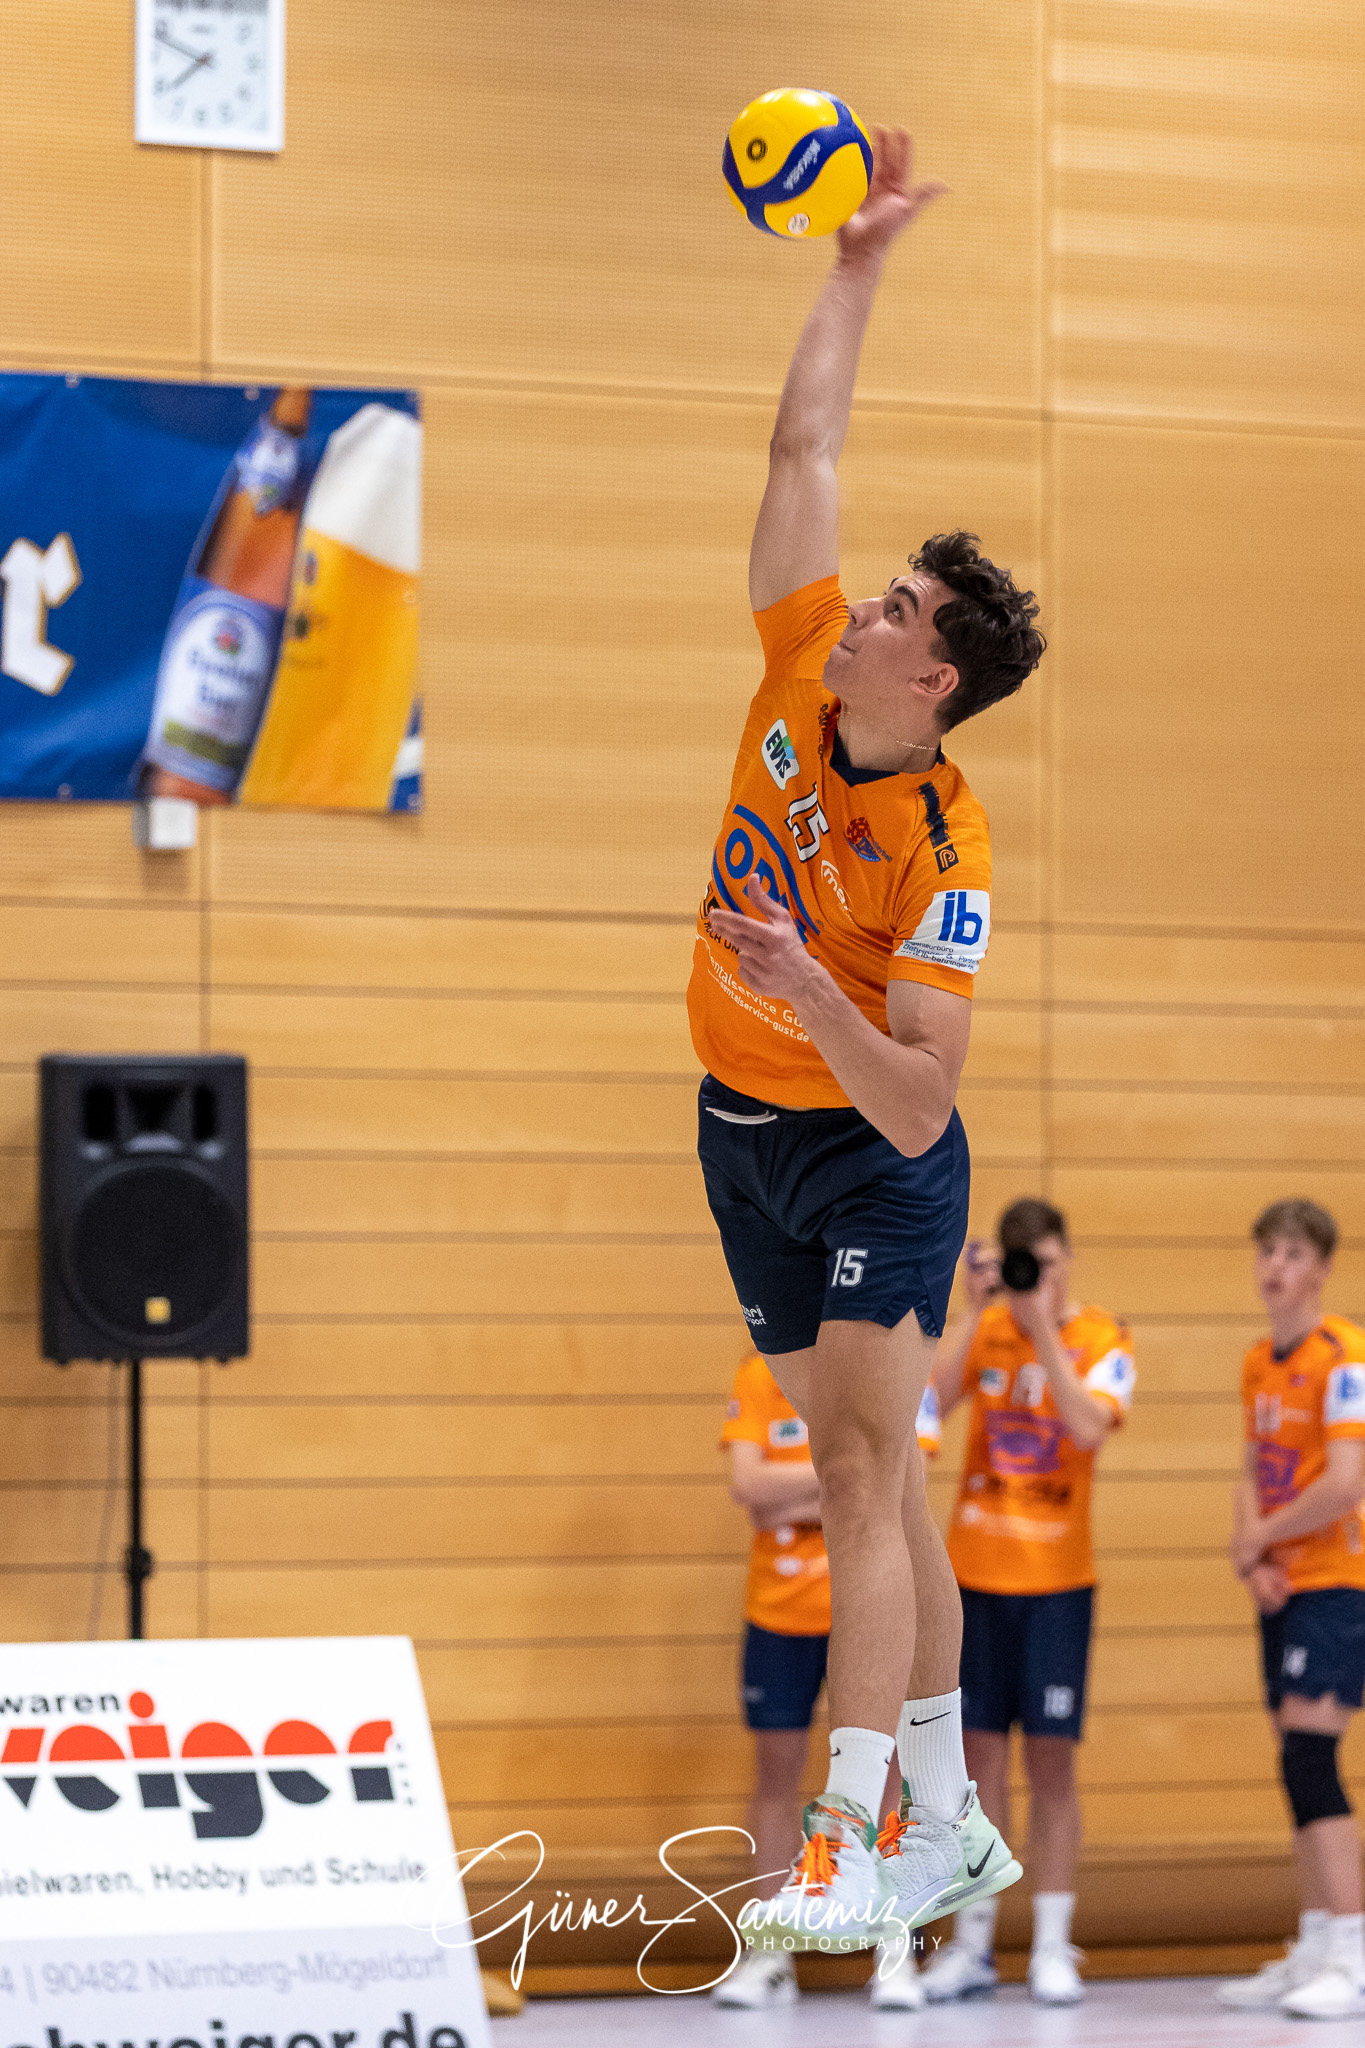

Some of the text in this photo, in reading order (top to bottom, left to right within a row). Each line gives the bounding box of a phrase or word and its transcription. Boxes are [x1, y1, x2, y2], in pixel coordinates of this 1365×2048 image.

[766, 729, 791, 779] EVIS
[784, 781, 831, 863] 15
[938, 891, 983, 946] ib
[831, 1248, 868, 1288] 15
[0, 1692, 121, 1714] waren
[0, 1857, 428, 1897] ielwaren, Hobby und Schule
[42, 1958, 142, 1996] 90482
